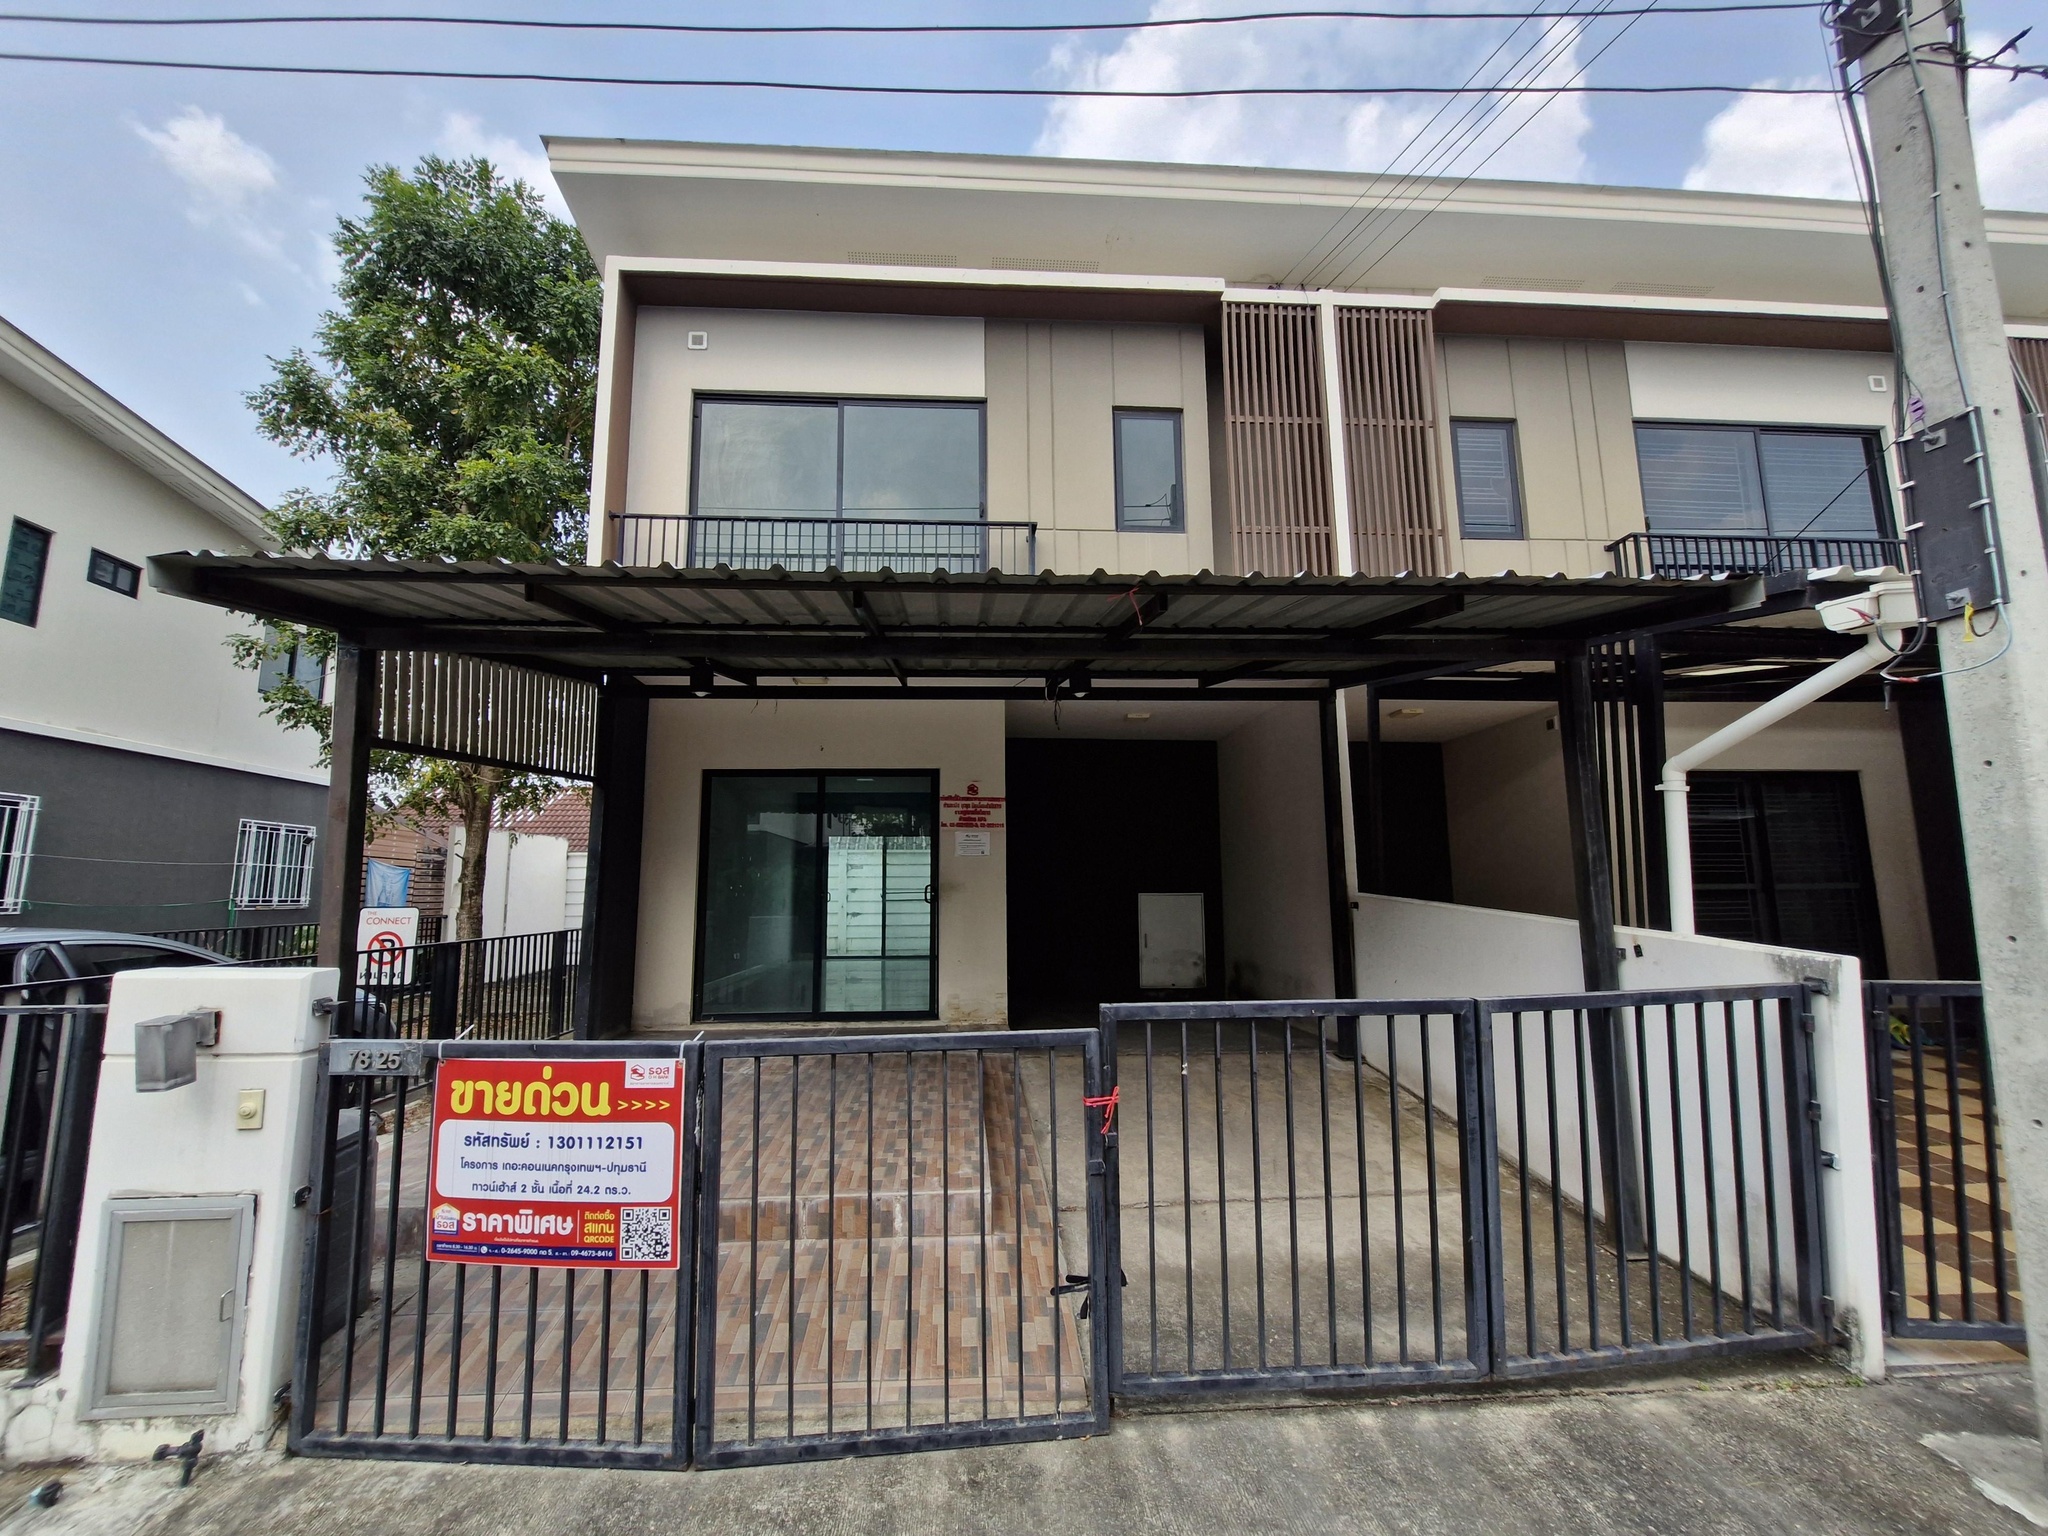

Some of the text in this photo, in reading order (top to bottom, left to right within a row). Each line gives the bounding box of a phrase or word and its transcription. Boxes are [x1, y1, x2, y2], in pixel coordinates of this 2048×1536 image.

[366, 916, 412, 925] CONNECT
[648, 1066, 670, 1075] ธอส
[450, 1065, 611, 1117] ขายด่วน
[464, 1132, 530, 1148] รหัสทรัพย์
[548, 1135, 643, 1150] 1301112151
[460, 1157, 498, 1170] โครงการ
[472, 1180, 631, 1195] ทาวน์เฮ้าส์ 2 ชั้น เนื้อที่ 24.2 ตร.ว.
[584, 1209, 615, 1221] ติดต่อซื้อ
[462, 1208, 574, 1236] ราคาพิเศษ
[583, 1222, 615, 1234] สแกน
[583, 1235, 614, 1244] QRCODE
[501, 1247, 538, 1255] 0-2645-9000
